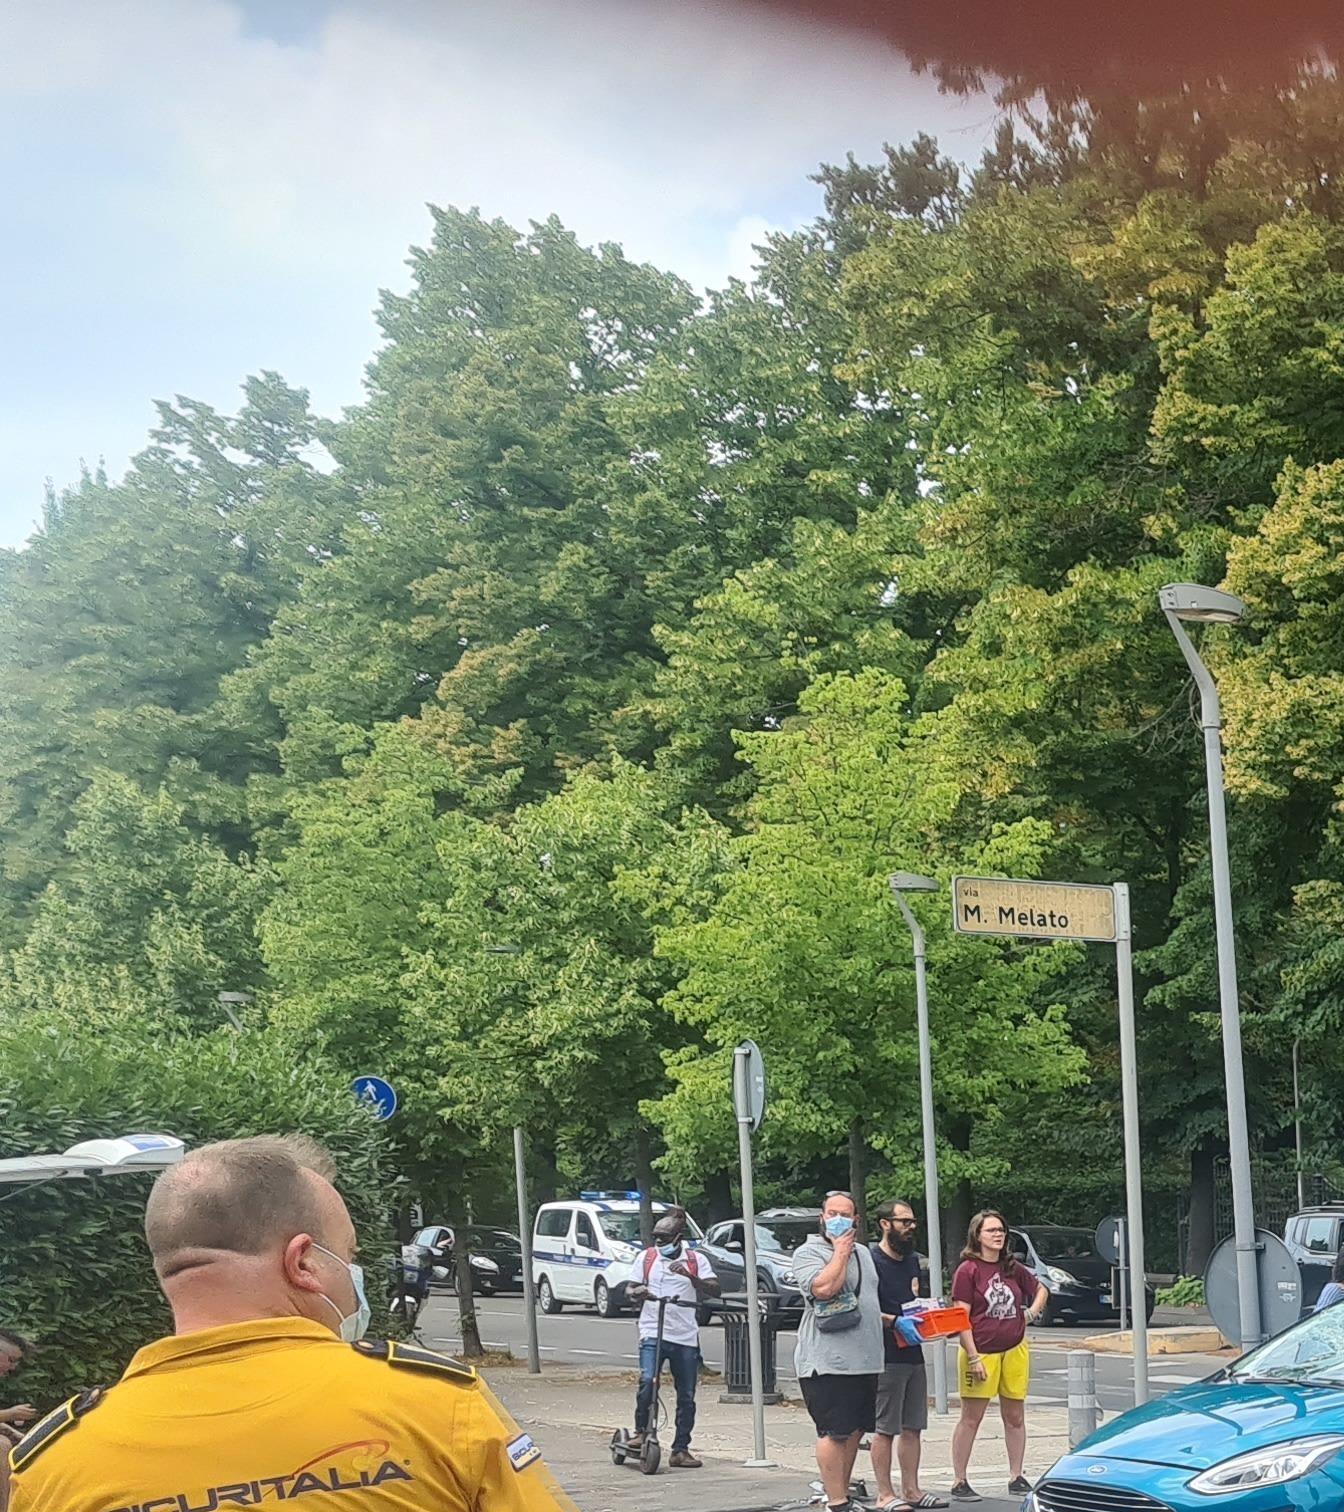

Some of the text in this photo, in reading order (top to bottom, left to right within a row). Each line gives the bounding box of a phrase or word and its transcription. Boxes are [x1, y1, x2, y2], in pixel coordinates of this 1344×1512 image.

[962, 887, 979, 898] via
[963, 904, 1069, 929] M. Melato
